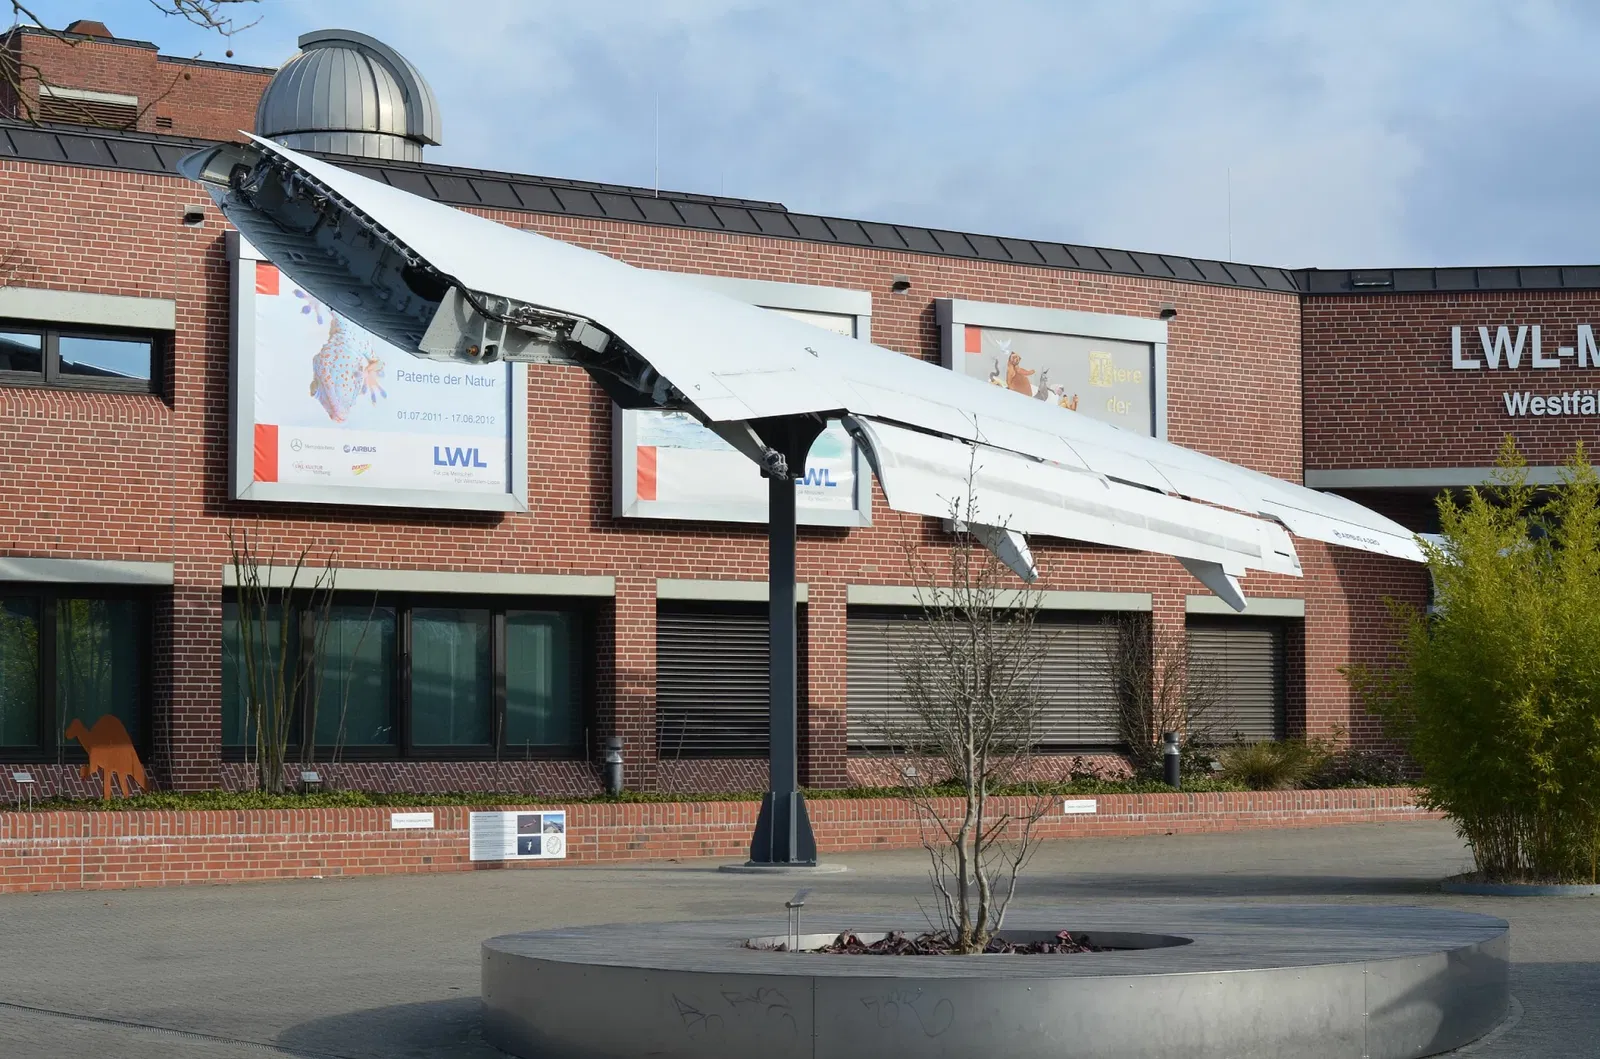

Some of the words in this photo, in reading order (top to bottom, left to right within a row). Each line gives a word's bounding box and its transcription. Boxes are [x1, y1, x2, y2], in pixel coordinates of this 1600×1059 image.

[396, 369, 440, 384] Patente
[443, 374, 462, 385] der
[465, 374, 496, 388] Natur
[1088, 351, 1142, 388] Tiere
[1106, 395, 1132, 415] der
[396, 410, 442, 422] 01.07.2011
[451, 414, 496, 425] 17.06.2012
[351, 445, 377, 453] AIRBUS
[433, 446, 488, 468] LWL
